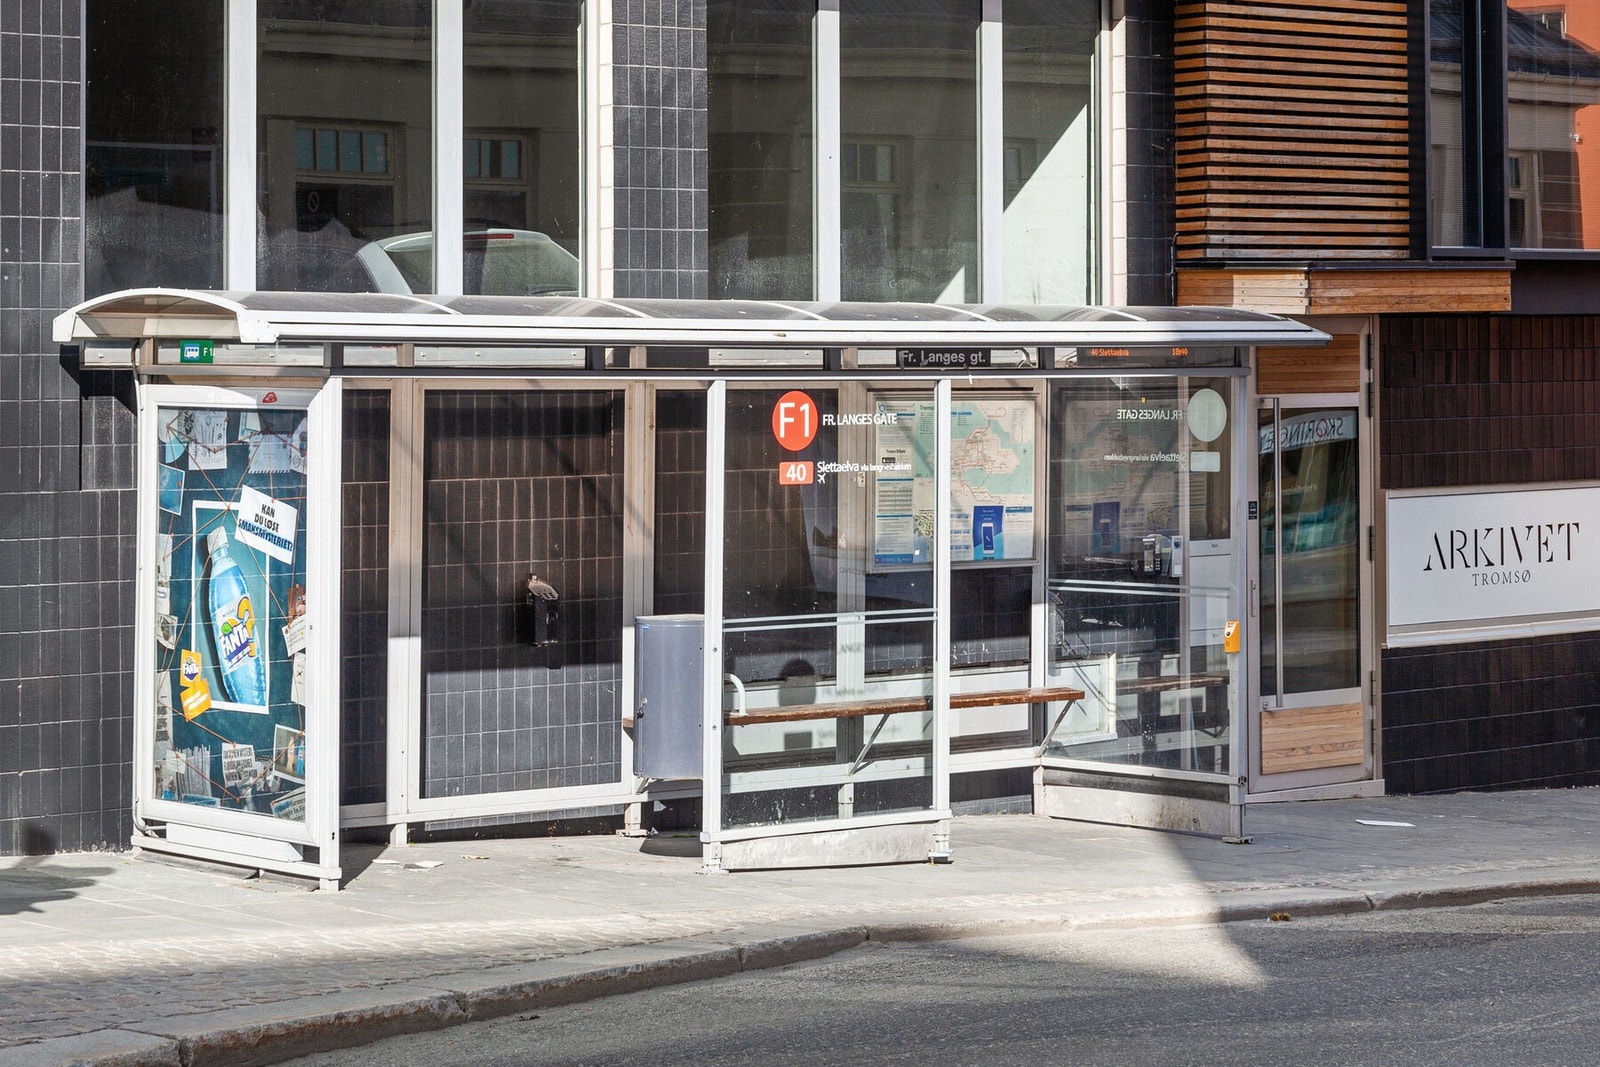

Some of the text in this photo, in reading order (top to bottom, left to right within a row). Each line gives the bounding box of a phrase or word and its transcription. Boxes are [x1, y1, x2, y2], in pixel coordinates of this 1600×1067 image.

[900, 350, 986, 365] Fr. Langes gt.
[780, 402, 810, 438] F1
[822, 412, 898, 426] FR. LANGES GATE
[786, 464, 807, 481] 40
[817, 461, 859, 473] Slettaelva
[861, 464, 870, 472] via
[262, 503, 275, 518] KAN
[254, 513, 280, 533] DU LØSE
[1423, 522, 1580, 571] ARKIVET
[1472, 569, 1532, 587] TROMSØ
